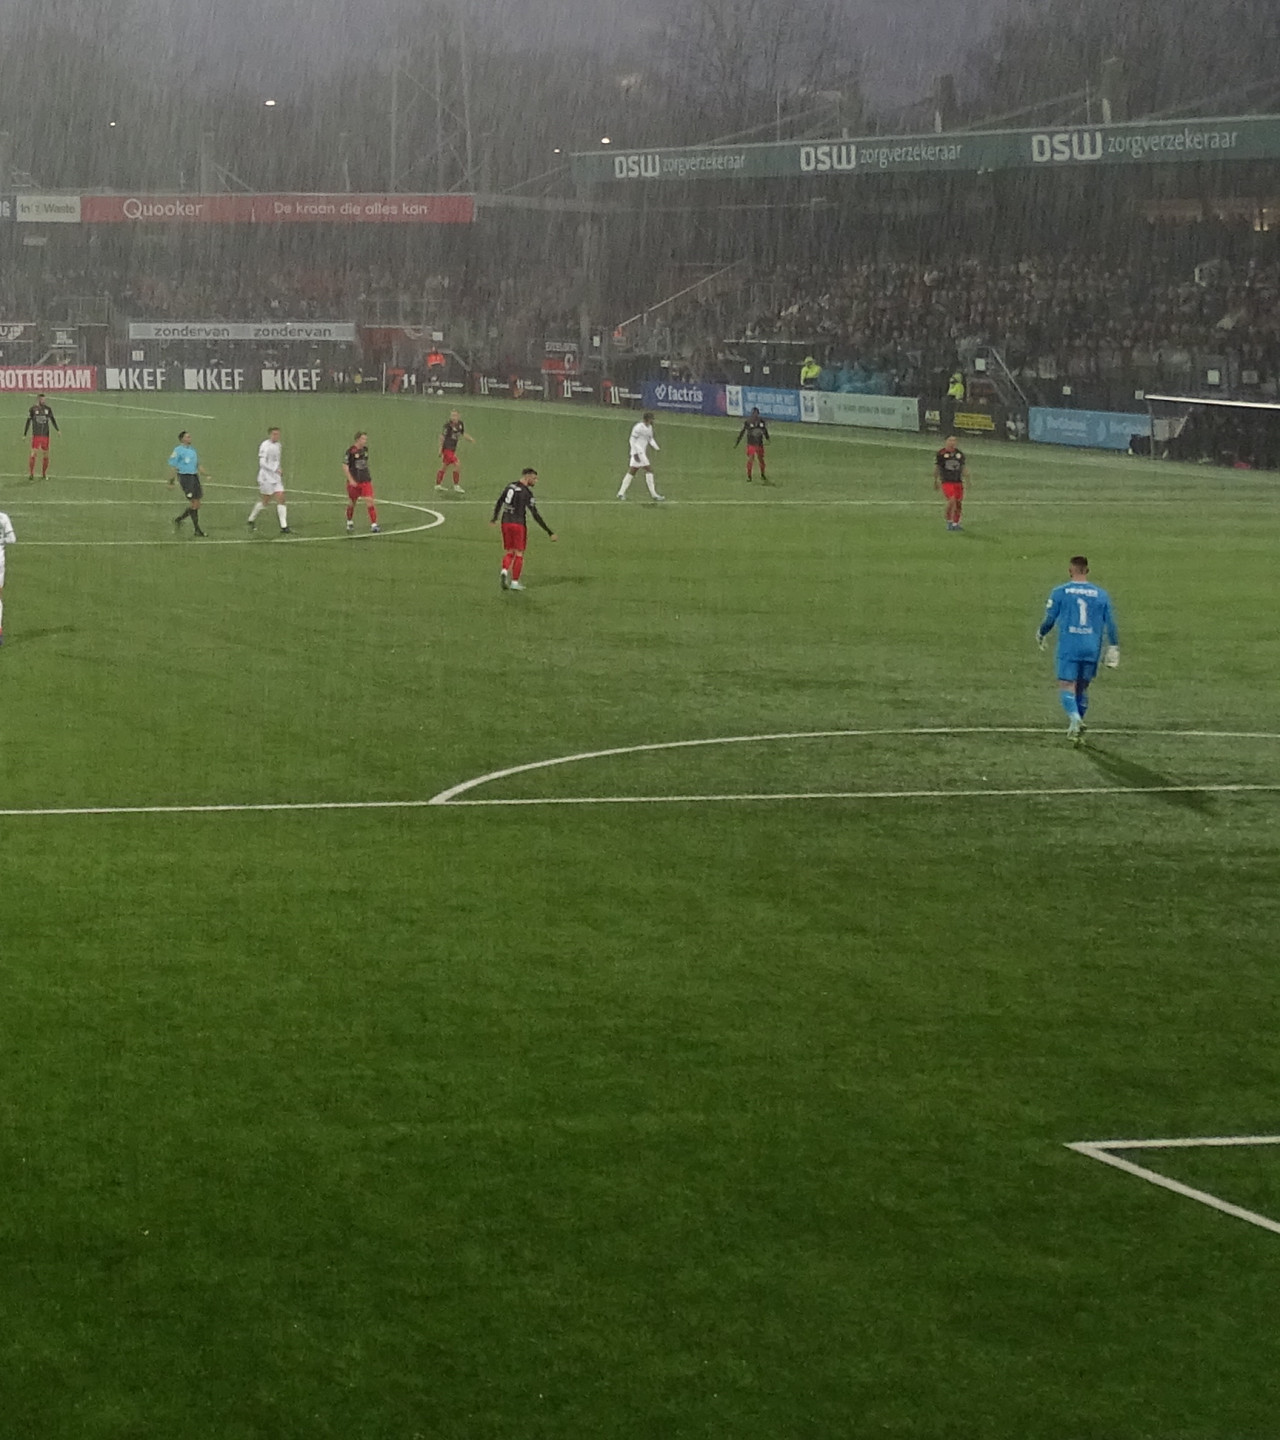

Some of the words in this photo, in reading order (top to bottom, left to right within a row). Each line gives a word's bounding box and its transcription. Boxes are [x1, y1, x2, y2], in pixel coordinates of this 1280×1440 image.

[1031, 131, 1103, 163] DSW
[1107, 127, 1238, 158] zorgverzekeraar
[800, 144, 857, 172] DSW
[860, 141, 962, 168] zorgverzekeraar
[613, 155, 660, 179] DSW
[123, 198, 203, 218] Quooker
[274, 202, 292, 214] De
[296, 202, 335, 215] kraan
[340, 202, 360, 215] die
[365, 202, 398, 215] alles
[401, 202, 428, 215] kan
[154, 326, 230, 338] zondervan
[253, 326, 332, 338] zondervan
[667, 384, 703, 403] factris
[505, 488, 515, 504] 9
[1076, 597, 1088, 626] 1
